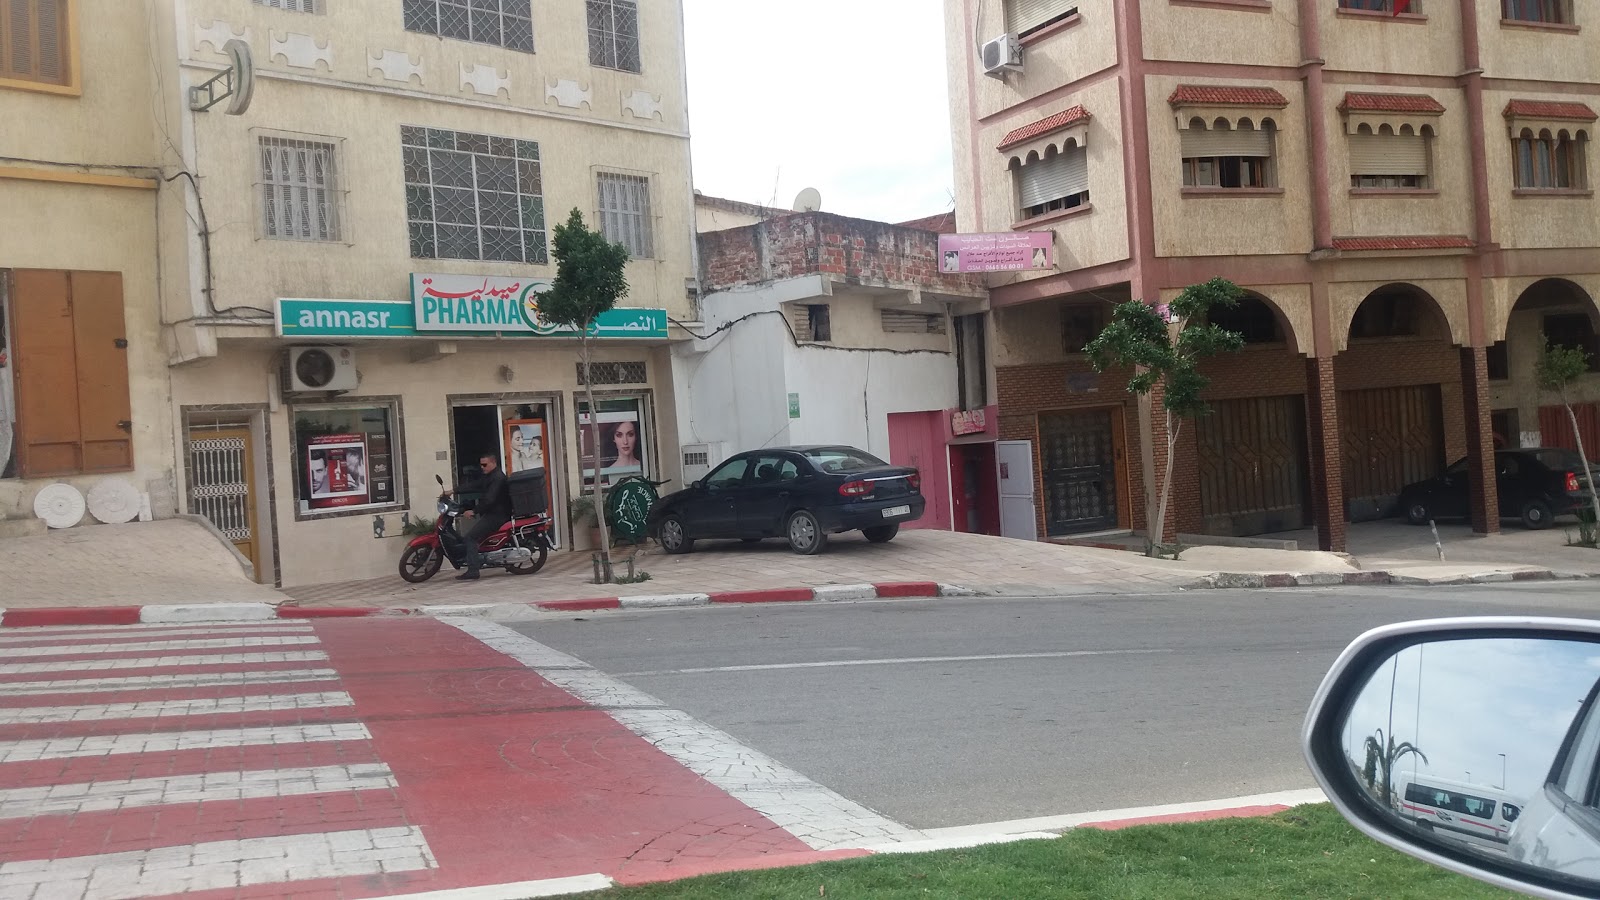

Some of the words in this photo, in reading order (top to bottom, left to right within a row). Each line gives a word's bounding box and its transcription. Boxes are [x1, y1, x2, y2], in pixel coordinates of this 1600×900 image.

[421, 277, 520, 301] صيدلية
[299, 309, 391, 328] annasr
[590, 315, 656, 335] النصر
